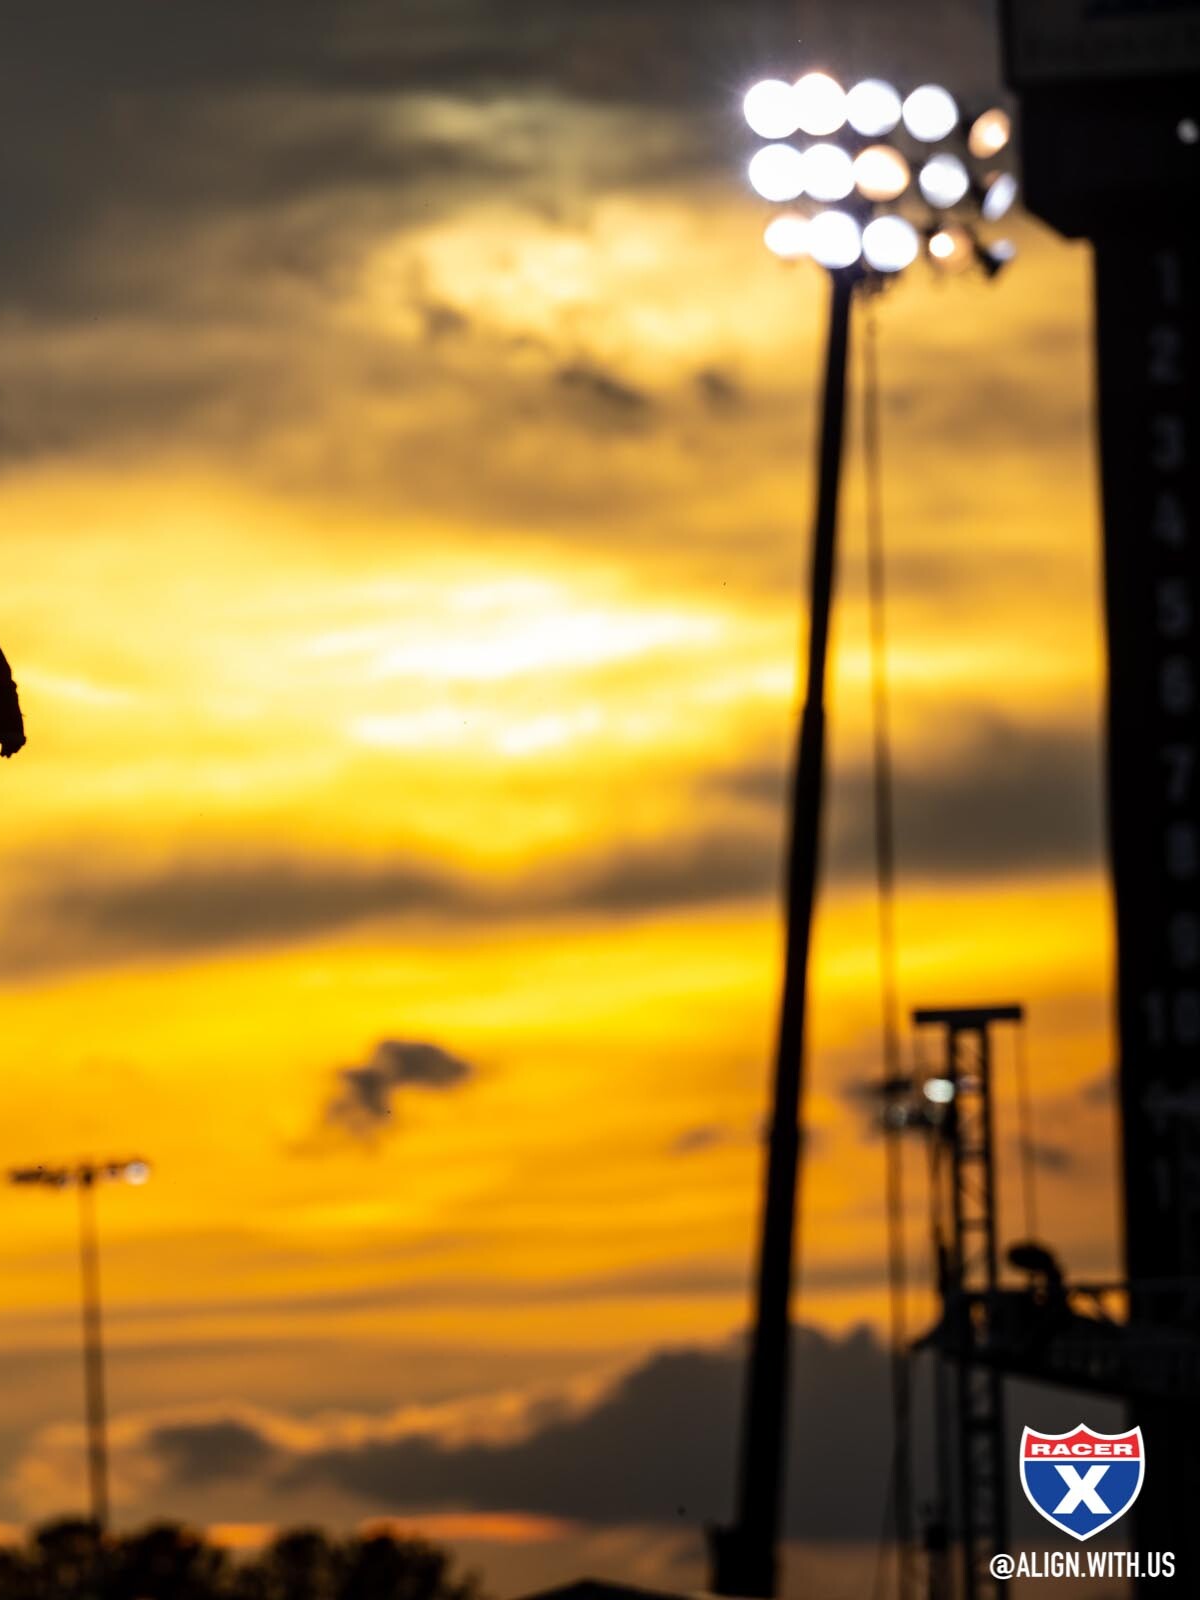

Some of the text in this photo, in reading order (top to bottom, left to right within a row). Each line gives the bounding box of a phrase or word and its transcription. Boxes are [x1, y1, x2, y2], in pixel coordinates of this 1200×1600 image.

[1148, 322, 1183, 384] 2
[1152, 412, 1185, 470] 3
[1153, 490, 1187, 547] 4
[1155, 576, 1191, 638] 5
[1159, 741, 1197, 805] 7
